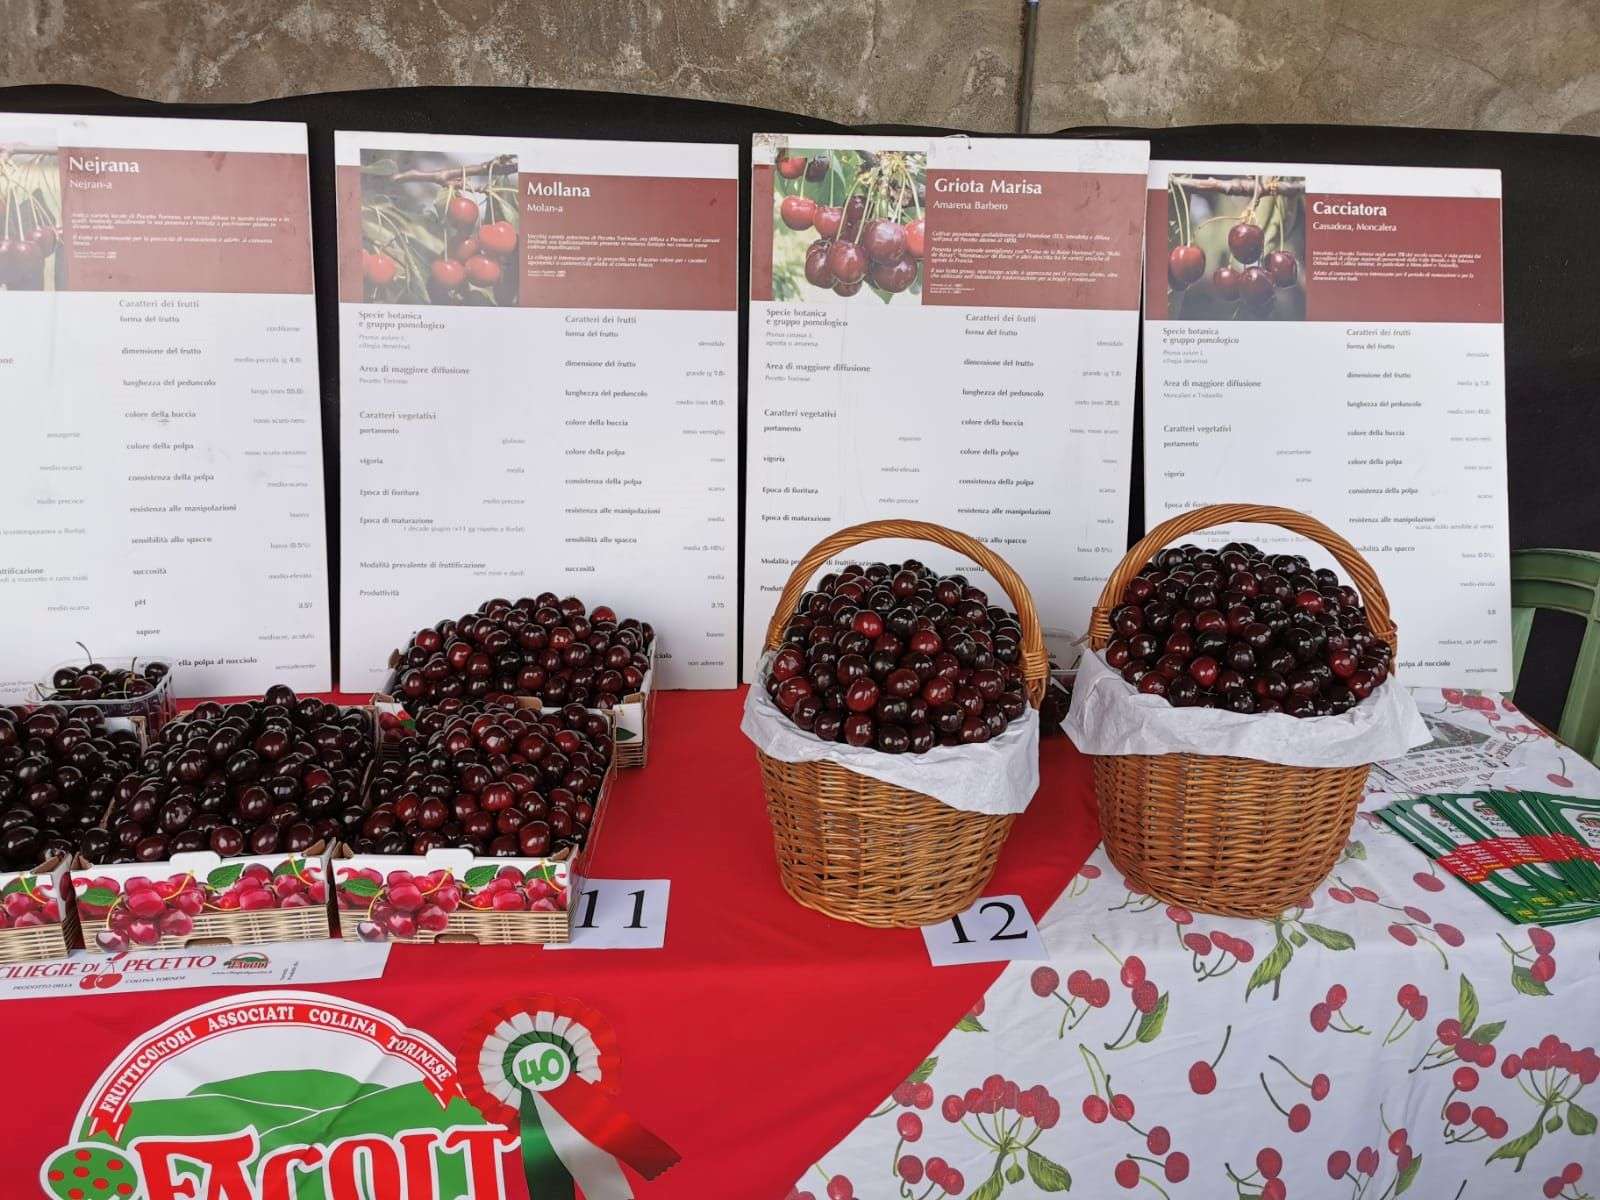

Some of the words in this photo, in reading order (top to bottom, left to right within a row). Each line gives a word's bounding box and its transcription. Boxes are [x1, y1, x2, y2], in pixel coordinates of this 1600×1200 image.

[69, 157, 140, 174] Nejrana
[70, 180, 112, 191] Nejran-a
[528, 182, 591, 198] Mollana
[935, 178, 983, 193] Griota
[990, 179, 1042, 195] Marisa
[528, 204, 564, 212] Molan-a
[933, 201, 971, 210] Amarena
[975, 202, 1008, 210] Barbero
[1313, 201, 1386, 216] Cacciatora
[1356, 223, 1396, 232] Moncalera
[119, 300, 158, 308] Caratteri
[161, 300, 174, 308] dei
[177, 300, 199, 308] frutti
[359, 311, 384, 320] Specie
[398, 321, 445, 330] pomologico
[803, 320, 848, 328] pomologico
[392, 367, 430, 375] maggiore
[796, 364, 830, 372] maggiore
[833, 364, 871, 372] diffusione
[398, 412, 436, 420] vegetativi
[800, 410, 836, 418] vegetativi
[173, 443, 194, 451] polpa
[194, 474, 214, 482] polpa
[360, 489, 380, 497] Epoca
[184, 505, 236, 514] manipolazioni
[614, 508, 660, 516] manipolazioni
[392, 562, 427, 570] prevalente
[134, 599, 146, 607] pH
[193, 660, 215, 668] polpa
[575, 890, 648, 928] 11
[952, 902, 1028, 944] 12
[82, 963, 100, 973] DI
[122, 955, 216, 972] PECETTO
[100, 1027, 195, 1113] FRUTTICOLTORI
[207, 1006, 294, 1032] ASSOCIATI
[308, 1008, 376, 1036] COLLINA
[386, 1036, 450, 1082] TORINESE
[519, 1049, 564, 1086] 40
